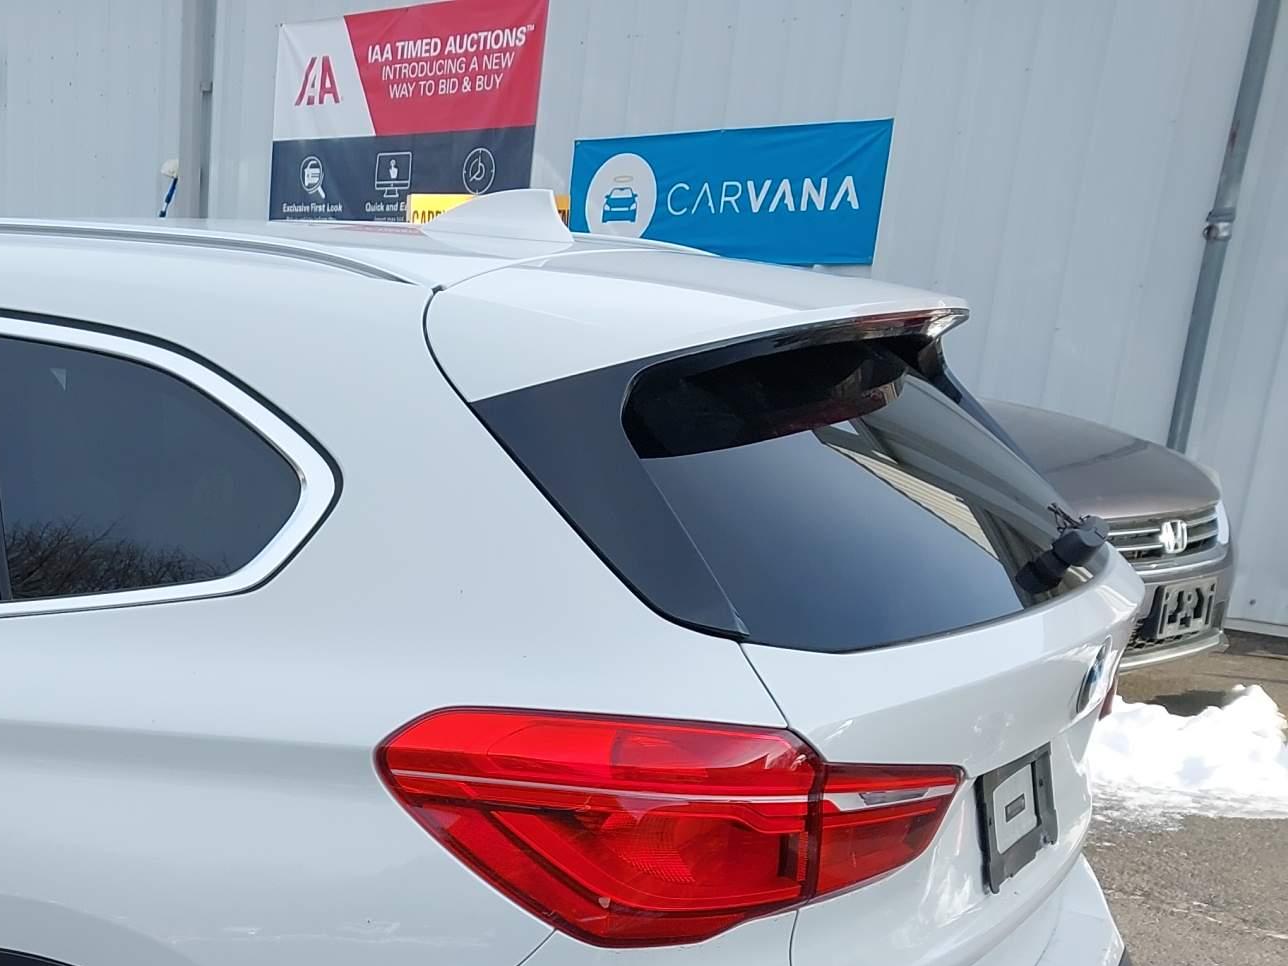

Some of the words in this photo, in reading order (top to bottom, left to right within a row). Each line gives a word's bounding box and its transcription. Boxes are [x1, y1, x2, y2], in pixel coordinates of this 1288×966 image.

[368, 43, 393, 64] IAA
[395, 38, 441, 60] TIMED
[382, 57, 466, 81] INTRODUCING
[468, 57, 479, 72] A
[482, 52, 515, 70] NEW
[389, 81, 416, 99] WAY
[418, 80, 435, 96] TO
[438, 77, 459, 95] BID
[462, 75, 472, 92] &
[475, 73, 504, 91] BUY
[282, 202, 310, 213] Exclusive
[311, 202, 326, 213] First
[327, 201, 343, 213] Look
[365, 201, 384, 213] Quick
[385, 202, 399, 212] and
[666, 175, 861, 216] CARVANA
